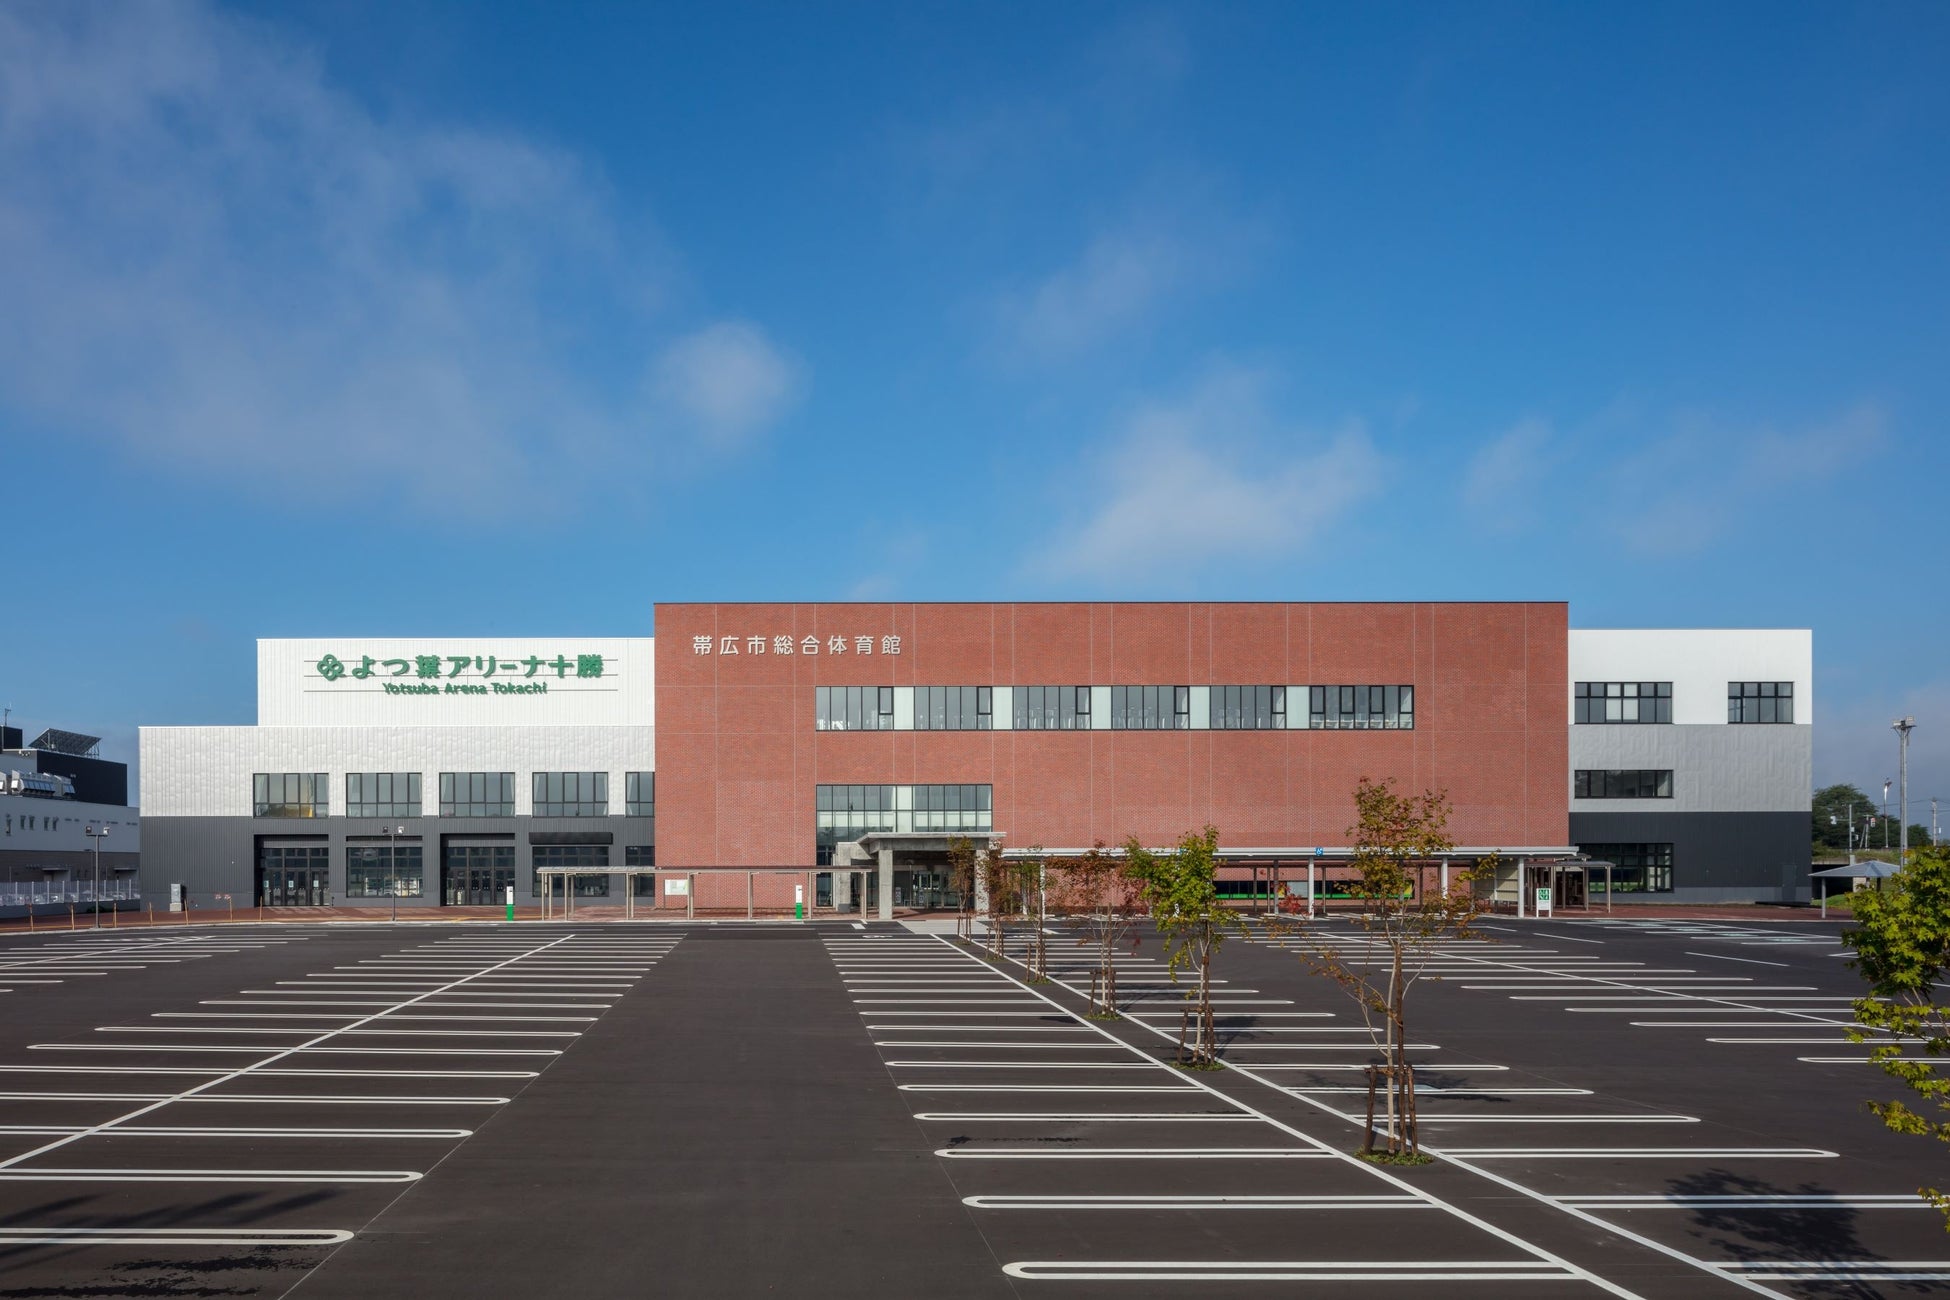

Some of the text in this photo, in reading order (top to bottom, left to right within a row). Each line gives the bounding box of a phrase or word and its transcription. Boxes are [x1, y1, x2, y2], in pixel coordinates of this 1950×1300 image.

[692, 635, 901, 655] 帯広市総合体育館
[351, 654, 603, 679] よつ葉アリーナ十勝
[382, 681, 548, 694] Yotsuba Arena Tokachi
